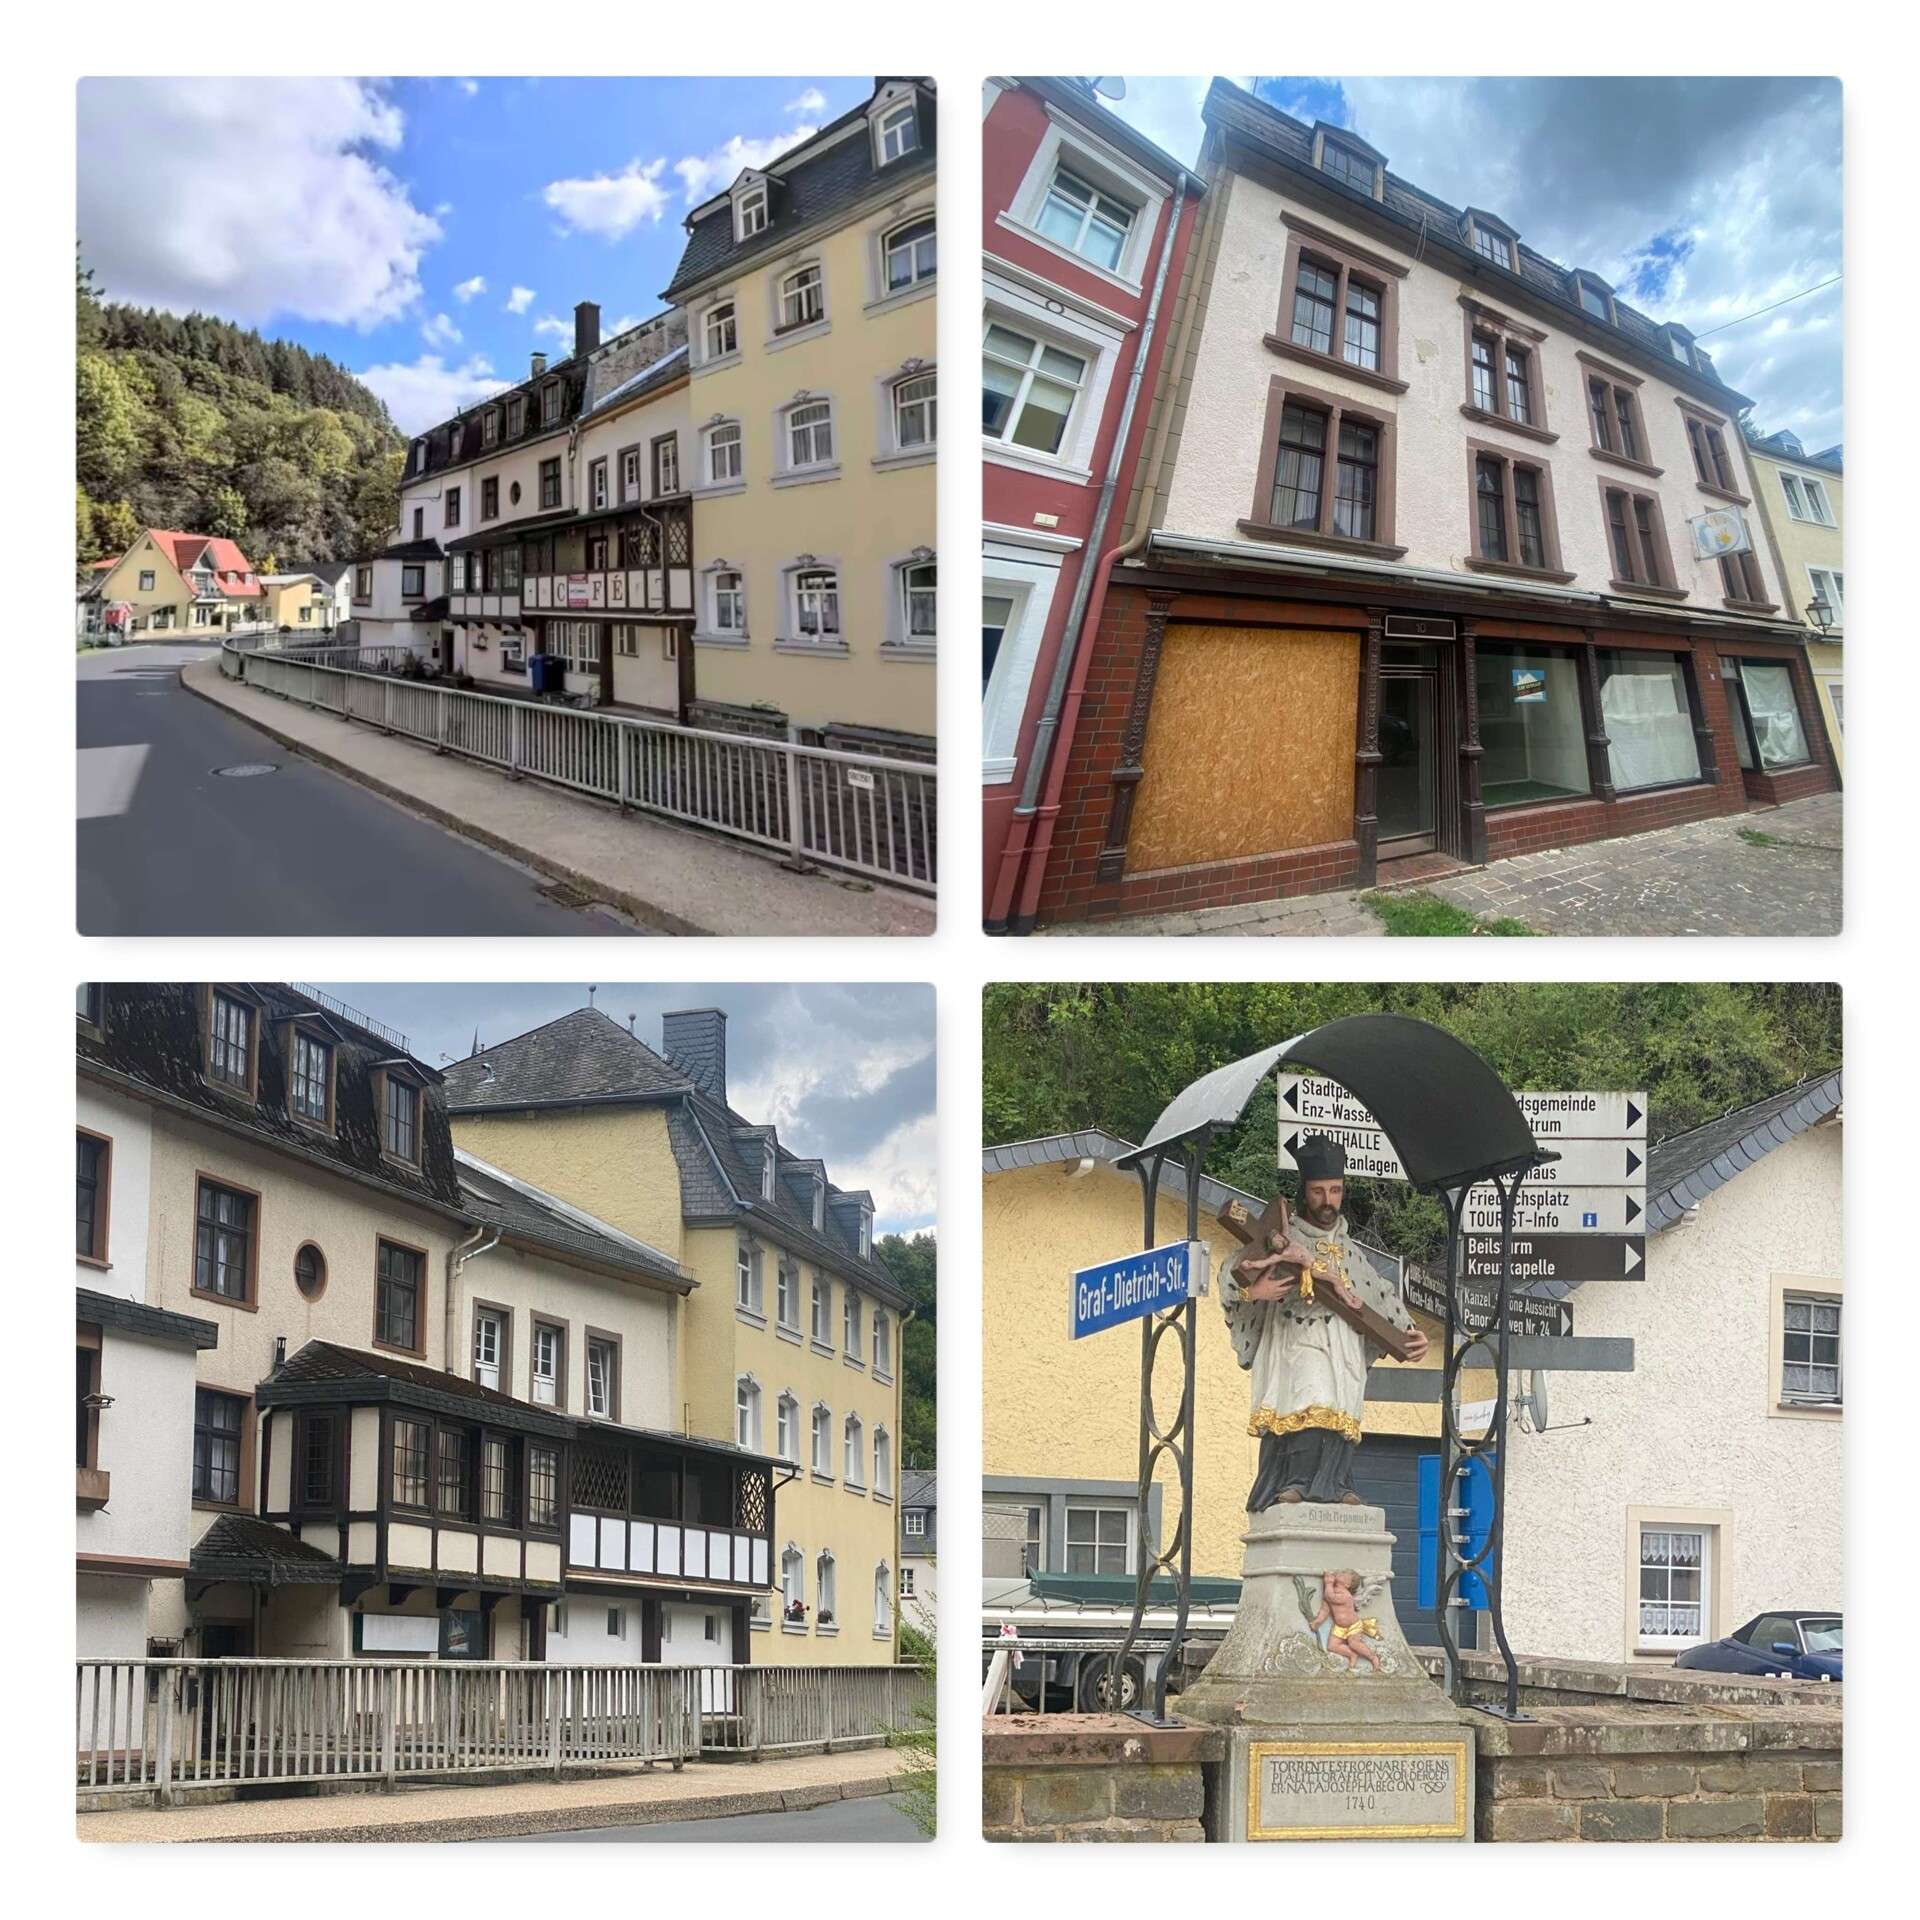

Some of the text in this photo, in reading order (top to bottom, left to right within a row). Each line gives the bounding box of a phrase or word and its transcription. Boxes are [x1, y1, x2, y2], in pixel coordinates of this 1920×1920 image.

[1517, 1094, 1596, 1115] dsgemeinde
[1529, 1117, 1561, 1132] trum
[1345, 1154, 1398, 1176] tanlagen
[1469, 1211, 1559, 1228] TOURST-Info
[1078, 1257, 1186, 1321] Graf-Dietrich-Str.
[1464, 1287, 1491, 1308] Kanzel
[1540, 1320, 1551, 1336] 24
[1346, 1795, 1375, 1810] 1740
